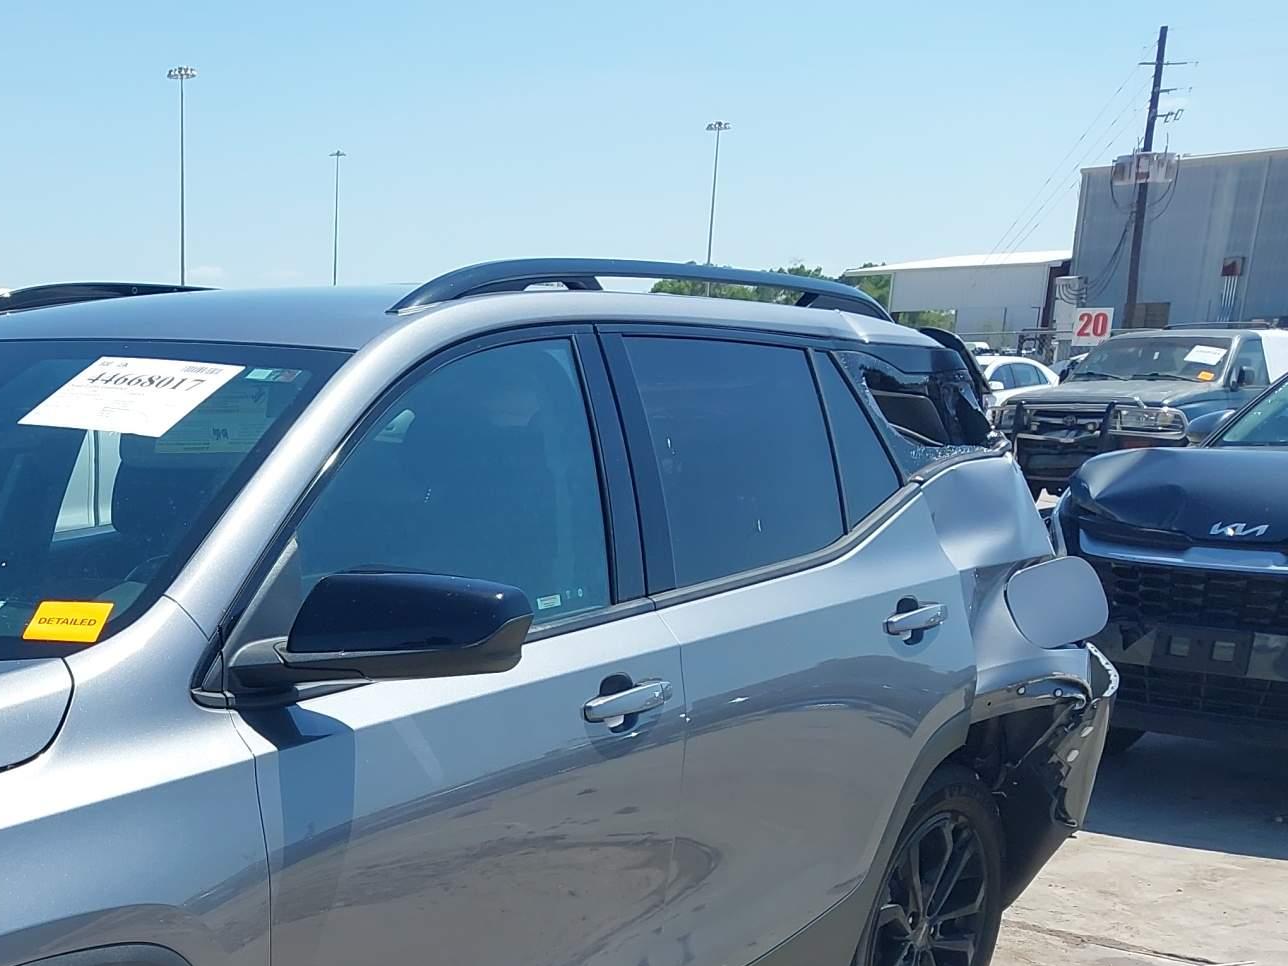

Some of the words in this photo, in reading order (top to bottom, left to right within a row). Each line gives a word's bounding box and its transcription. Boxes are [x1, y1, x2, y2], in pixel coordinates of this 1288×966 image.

[1076, 312, 1108, 337] 20
[87, 371, 207, 391] 44668017
[1209, 521, 1270, 537] KIA
[38, 616, 97, 626] DETAILED
